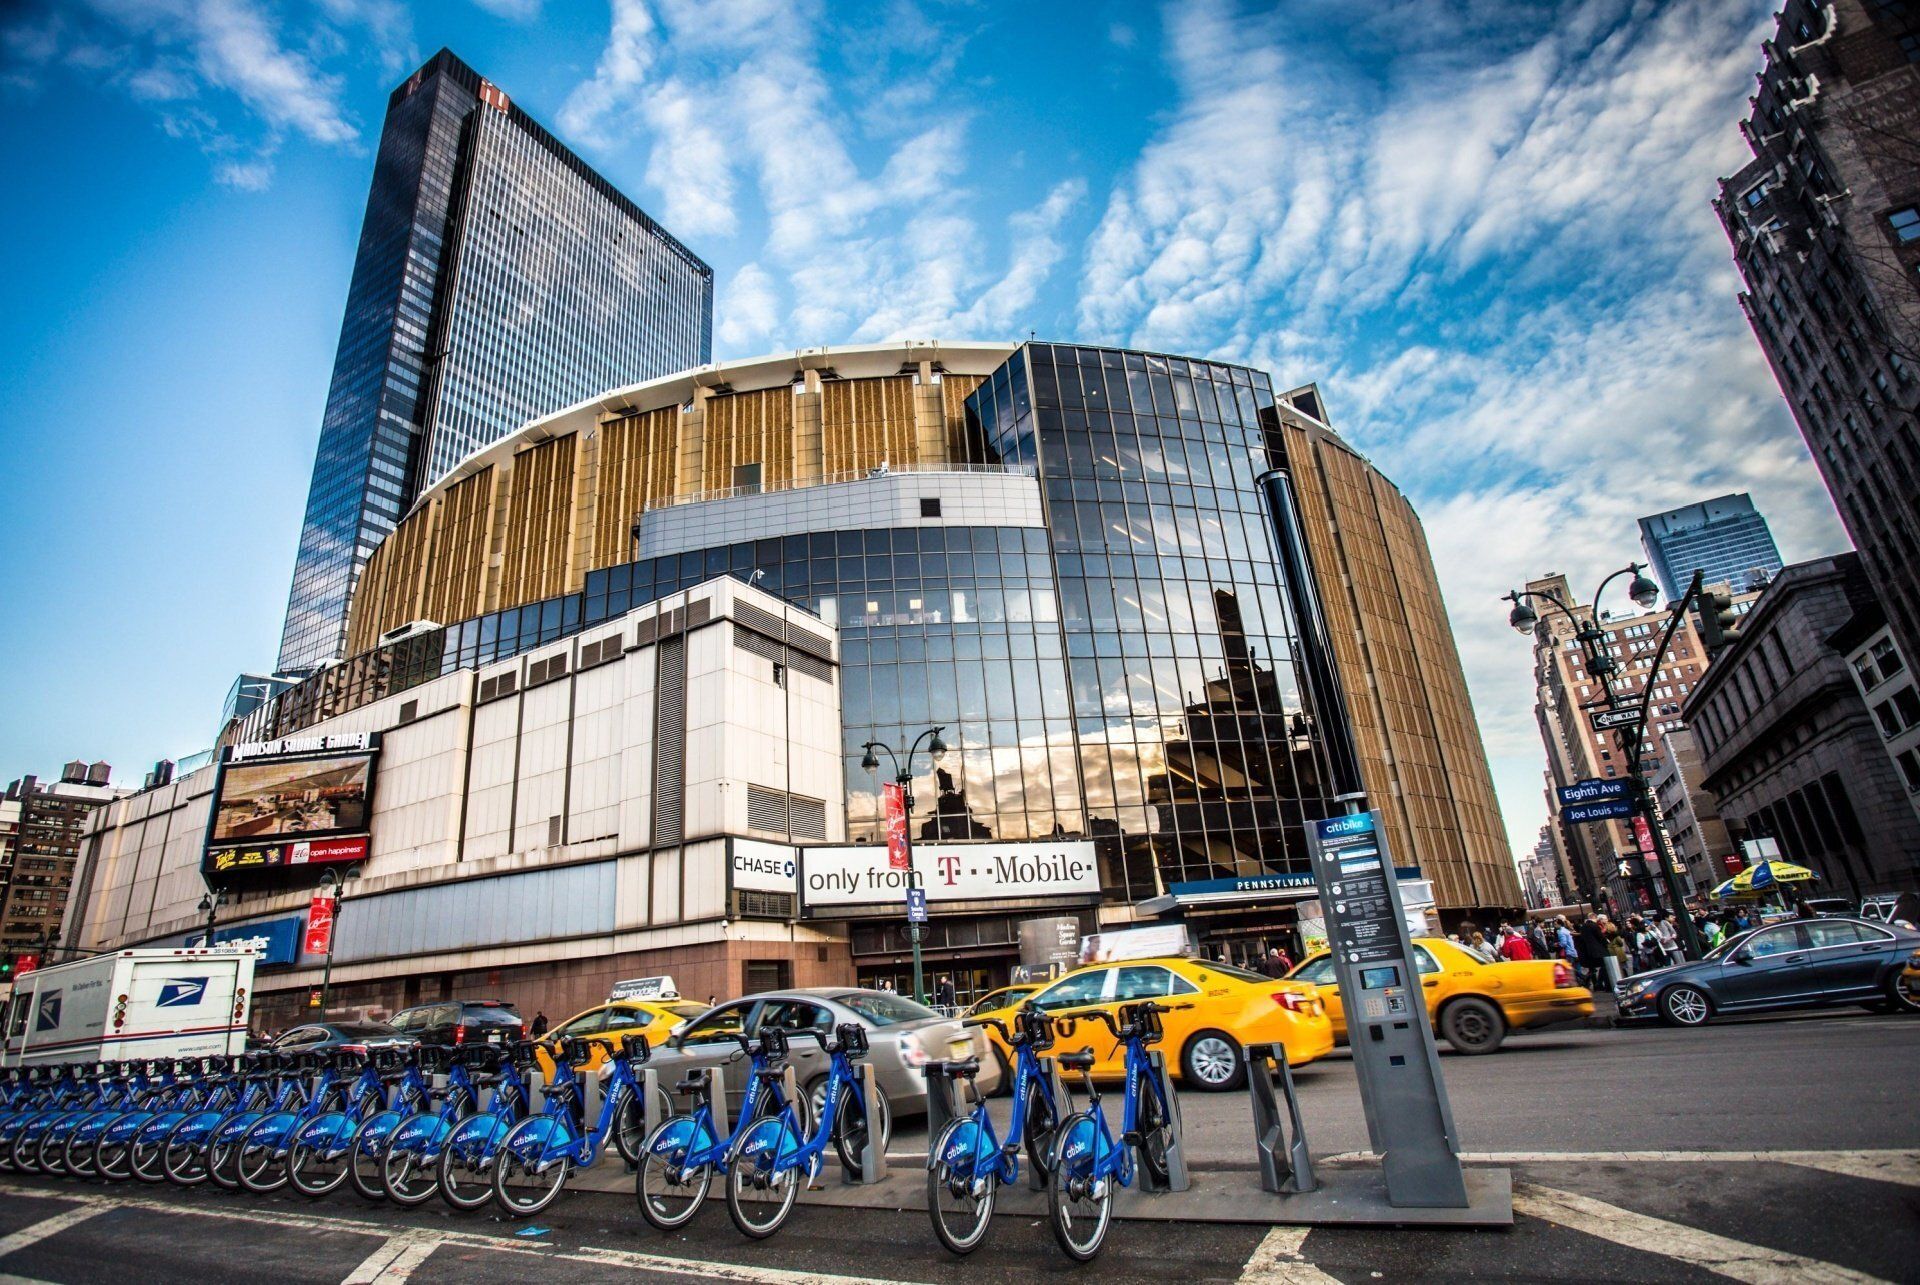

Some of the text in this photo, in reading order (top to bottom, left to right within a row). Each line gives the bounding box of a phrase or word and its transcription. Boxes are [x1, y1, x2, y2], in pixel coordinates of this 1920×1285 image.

[1621, 711, 1636, 719] WAY
[232, 734, 369, 761] MADISON SQUARE GARDEN
[1564, 784, 1621, 800] Eighth Ave
[1571, 811, 1586, 820] Joe
[1587, 806, 1612, 817] Louis
[1326, 823, 1342, 833] citi
[310, 849, 327, 857] open
[328, 845, 360, 855] happiness
[733, 856, 782, 875] CHASE
[809, 867, 860, 894] only
[866, 866, 924, 889] from
[993, 853, 1084, 884] Mobile
[1237, 877, 1316, 890] PENNSYLVANI
[513, 1135, 525, 1147] citi
[656, 1138, 667, 1151] citi
[745, 1142, 756, 1154] citi
[947, 1145, 957, 1160] citi
[1066, 1144, 1076, 1159] citi
